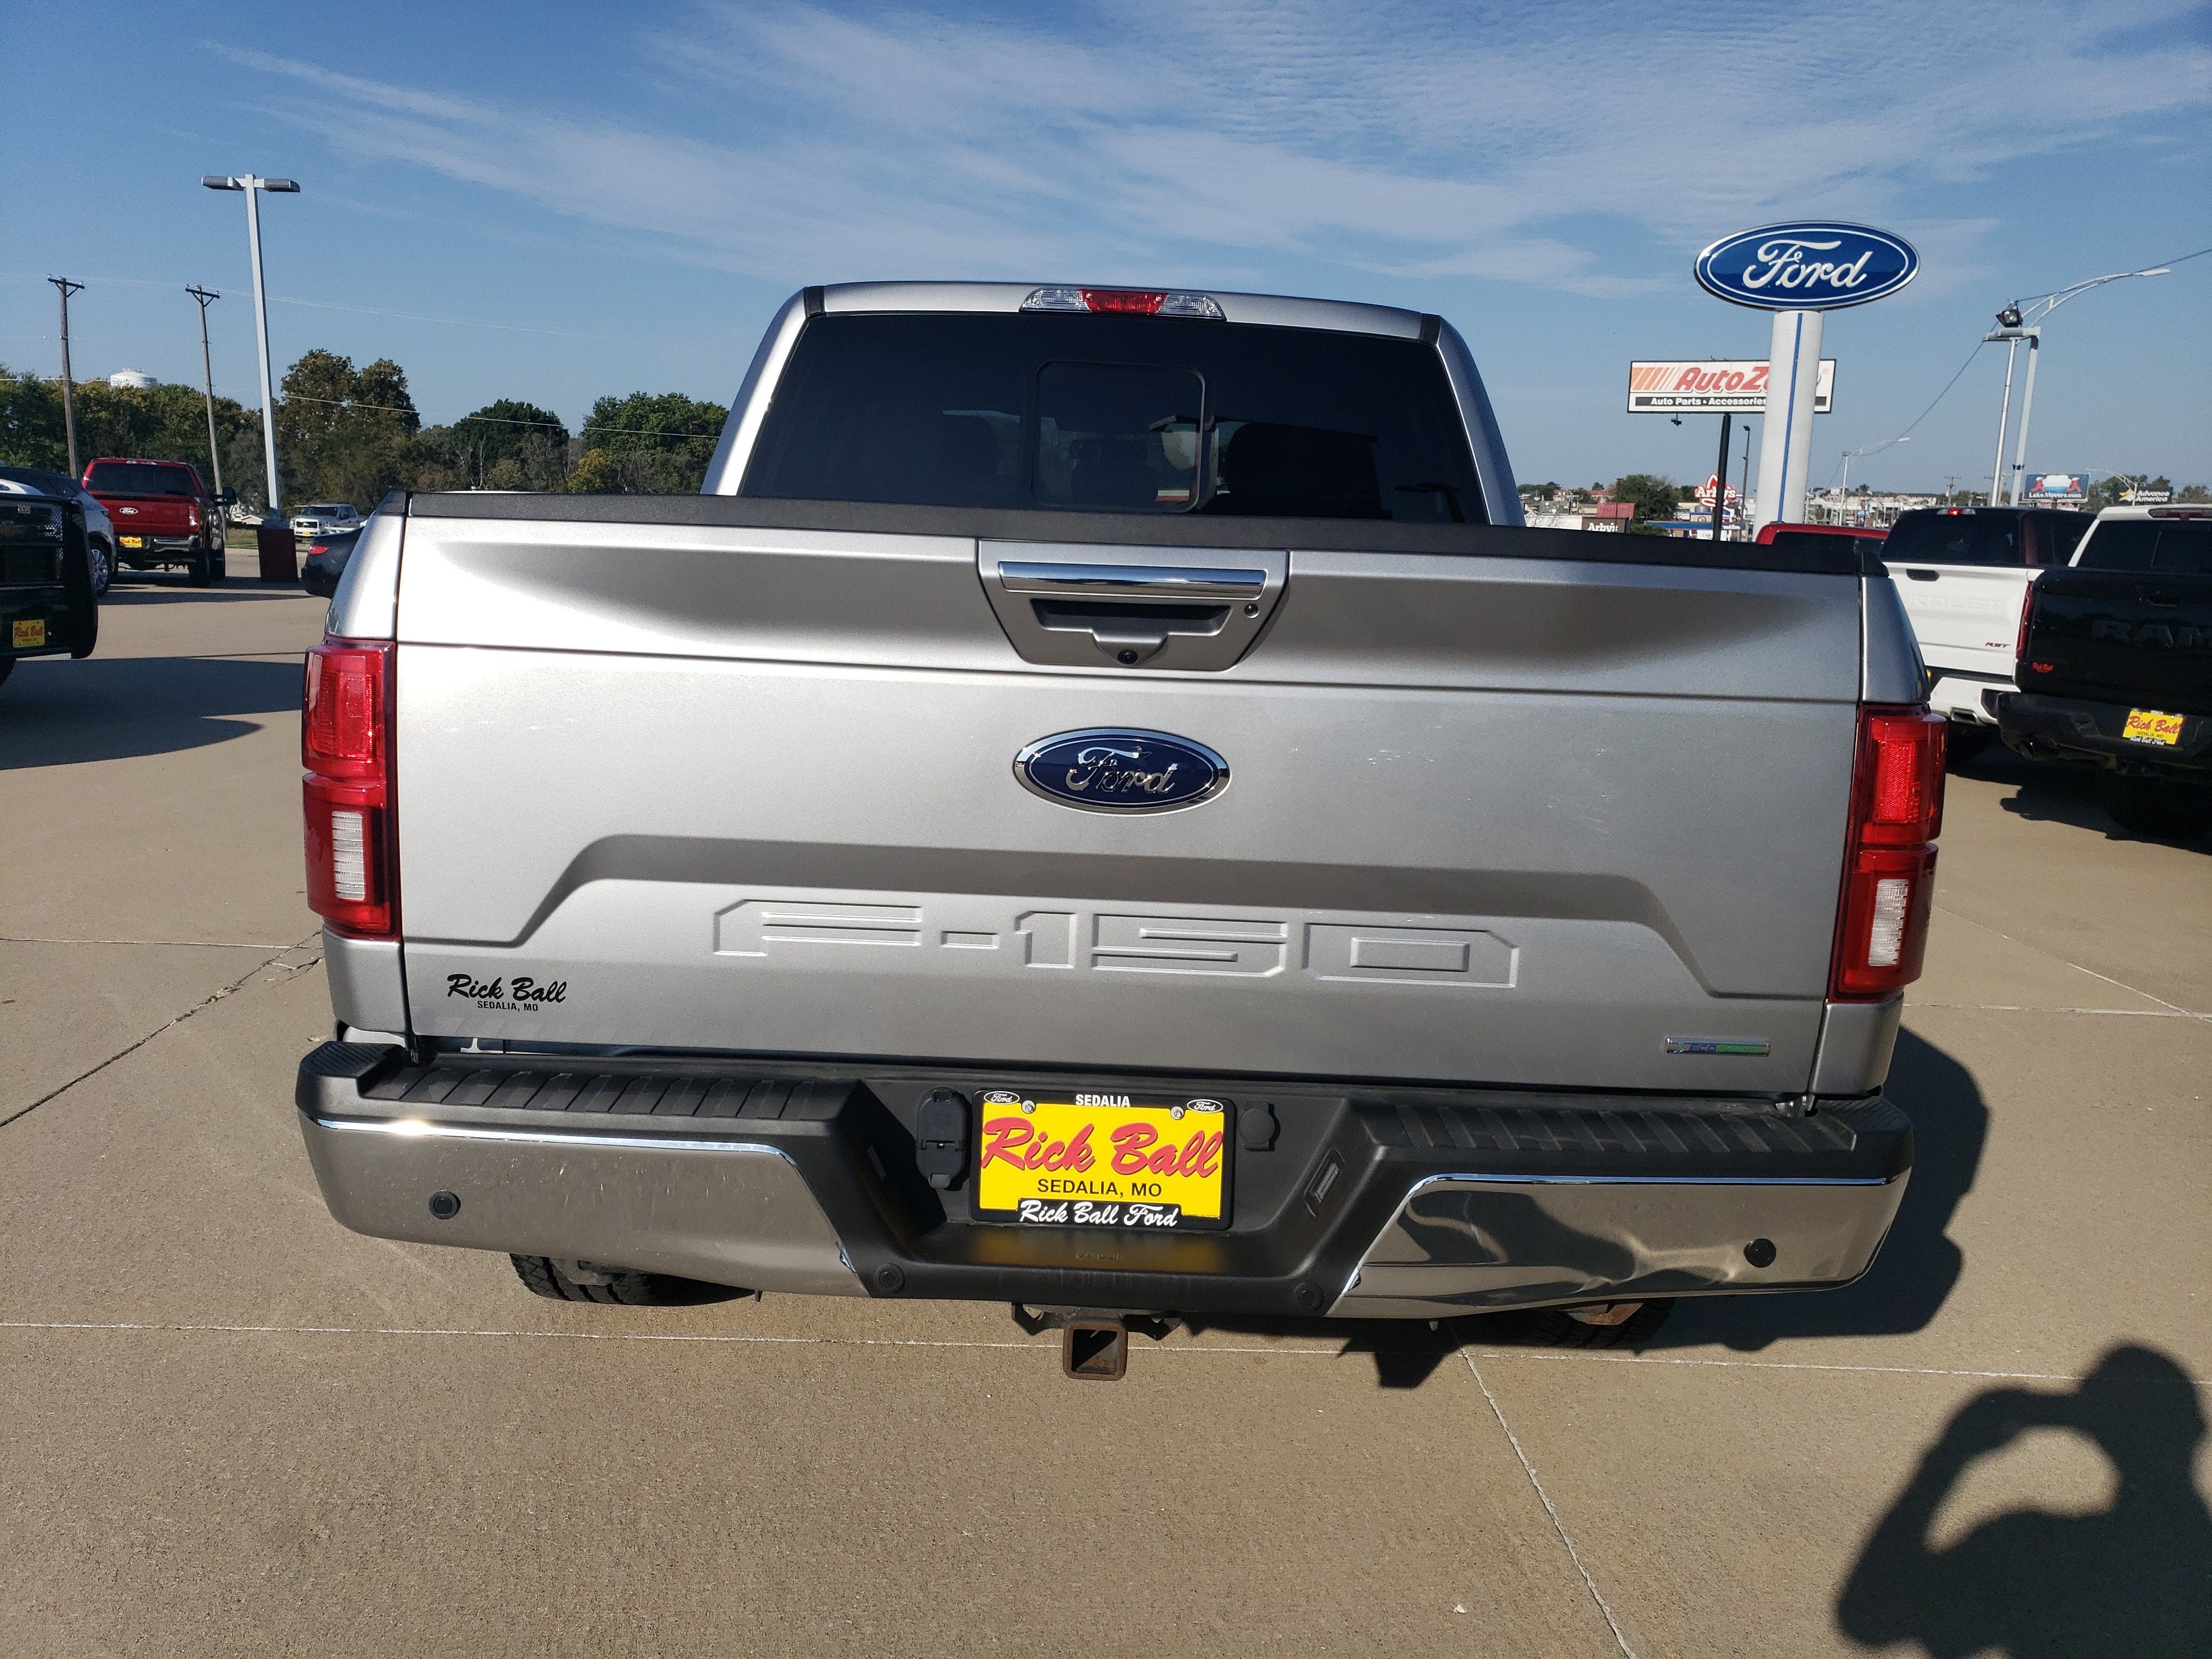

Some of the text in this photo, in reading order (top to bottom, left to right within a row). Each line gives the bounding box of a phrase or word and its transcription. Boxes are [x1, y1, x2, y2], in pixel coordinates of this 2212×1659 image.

[1742, 239, 1874, 289] Ford
[1672, 366, 1770, 391] AutoZ
[2126, 715, 2183, 735] Rick Ball
[1065, 746, 1178, 793] Ford
[713, 899, 1520, 988] F-150
[447, 973, 567, 1003] Rick Ball
[477, 1000, 538, 1012] SEDALIA, MO
[991, 1093, 1013, 1103] Ford
[1075, 1093, 1131, 1108] SEDALIA
[1194, 1101, 1216, 1111] Ford
[981, 1116, 1223, 1178] Rick Ball
[1037, 1178, 1162, 1198] SEDALIA, MO
[1019, 1199, 1179, 1227] Rick Ball Ford
